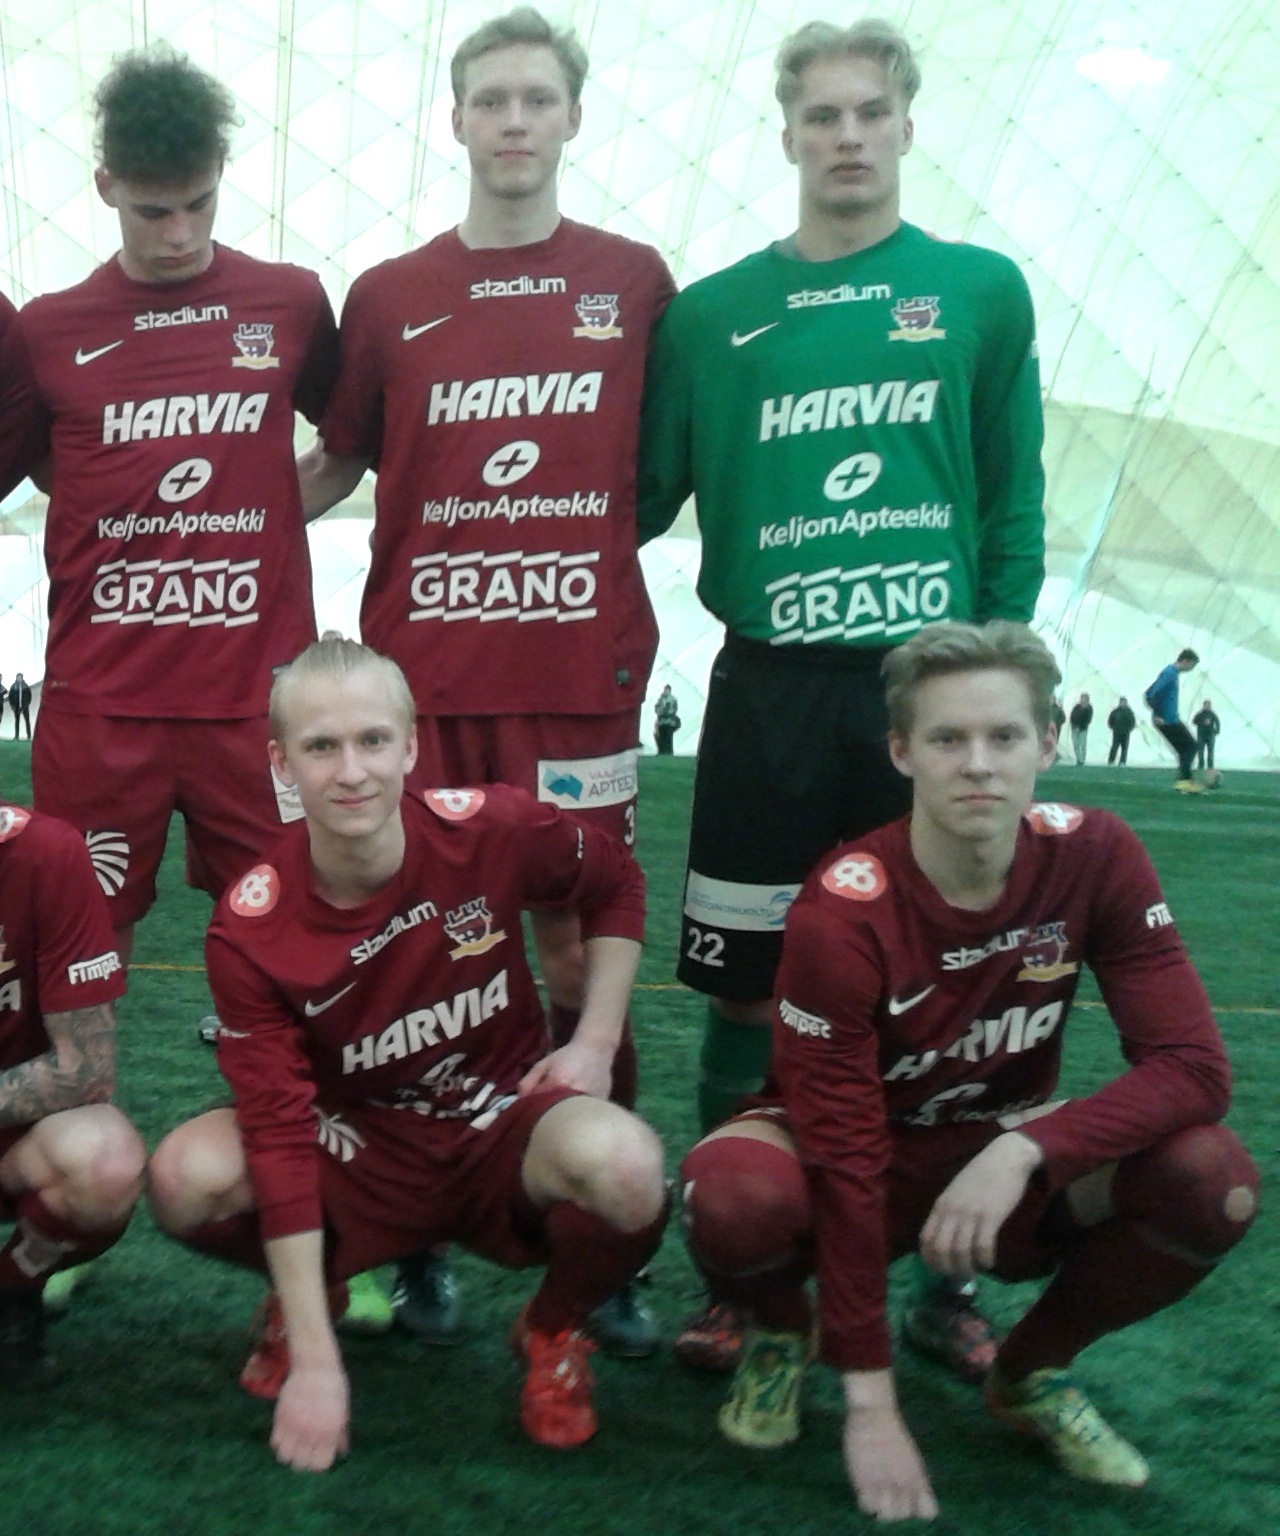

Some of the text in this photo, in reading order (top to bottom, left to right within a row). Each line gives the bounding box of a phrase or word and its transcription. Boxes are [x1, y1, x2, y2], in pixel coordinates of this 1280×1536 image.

[470, 276, 566, 300] stadium
[786, 283, 892, 310] stadium
[134, 304, 229, 331] stadium
[102, 392, 269, 445] HARVIA
[427, 371, 604, 426] HARVIA
[759, 379, 940, 443] HARVIA
[97, 508, 266, 542] KeljonApteekki
[422, 491, 609, 528] KeljonApteekki
[758, 503, 952, 551] KeljonApteekki
[92, 573, 259, 614] GRANO
[410, 566, 597, 609] GRANO
[770, 575, 950, 632] GRANO
[350, 900, 439, 966] stadium
[686, 926, 725, 968] 22
[341, 968, 509, 1075] HARVIA
[882, 1000, 1064, 1081] HRVIA
